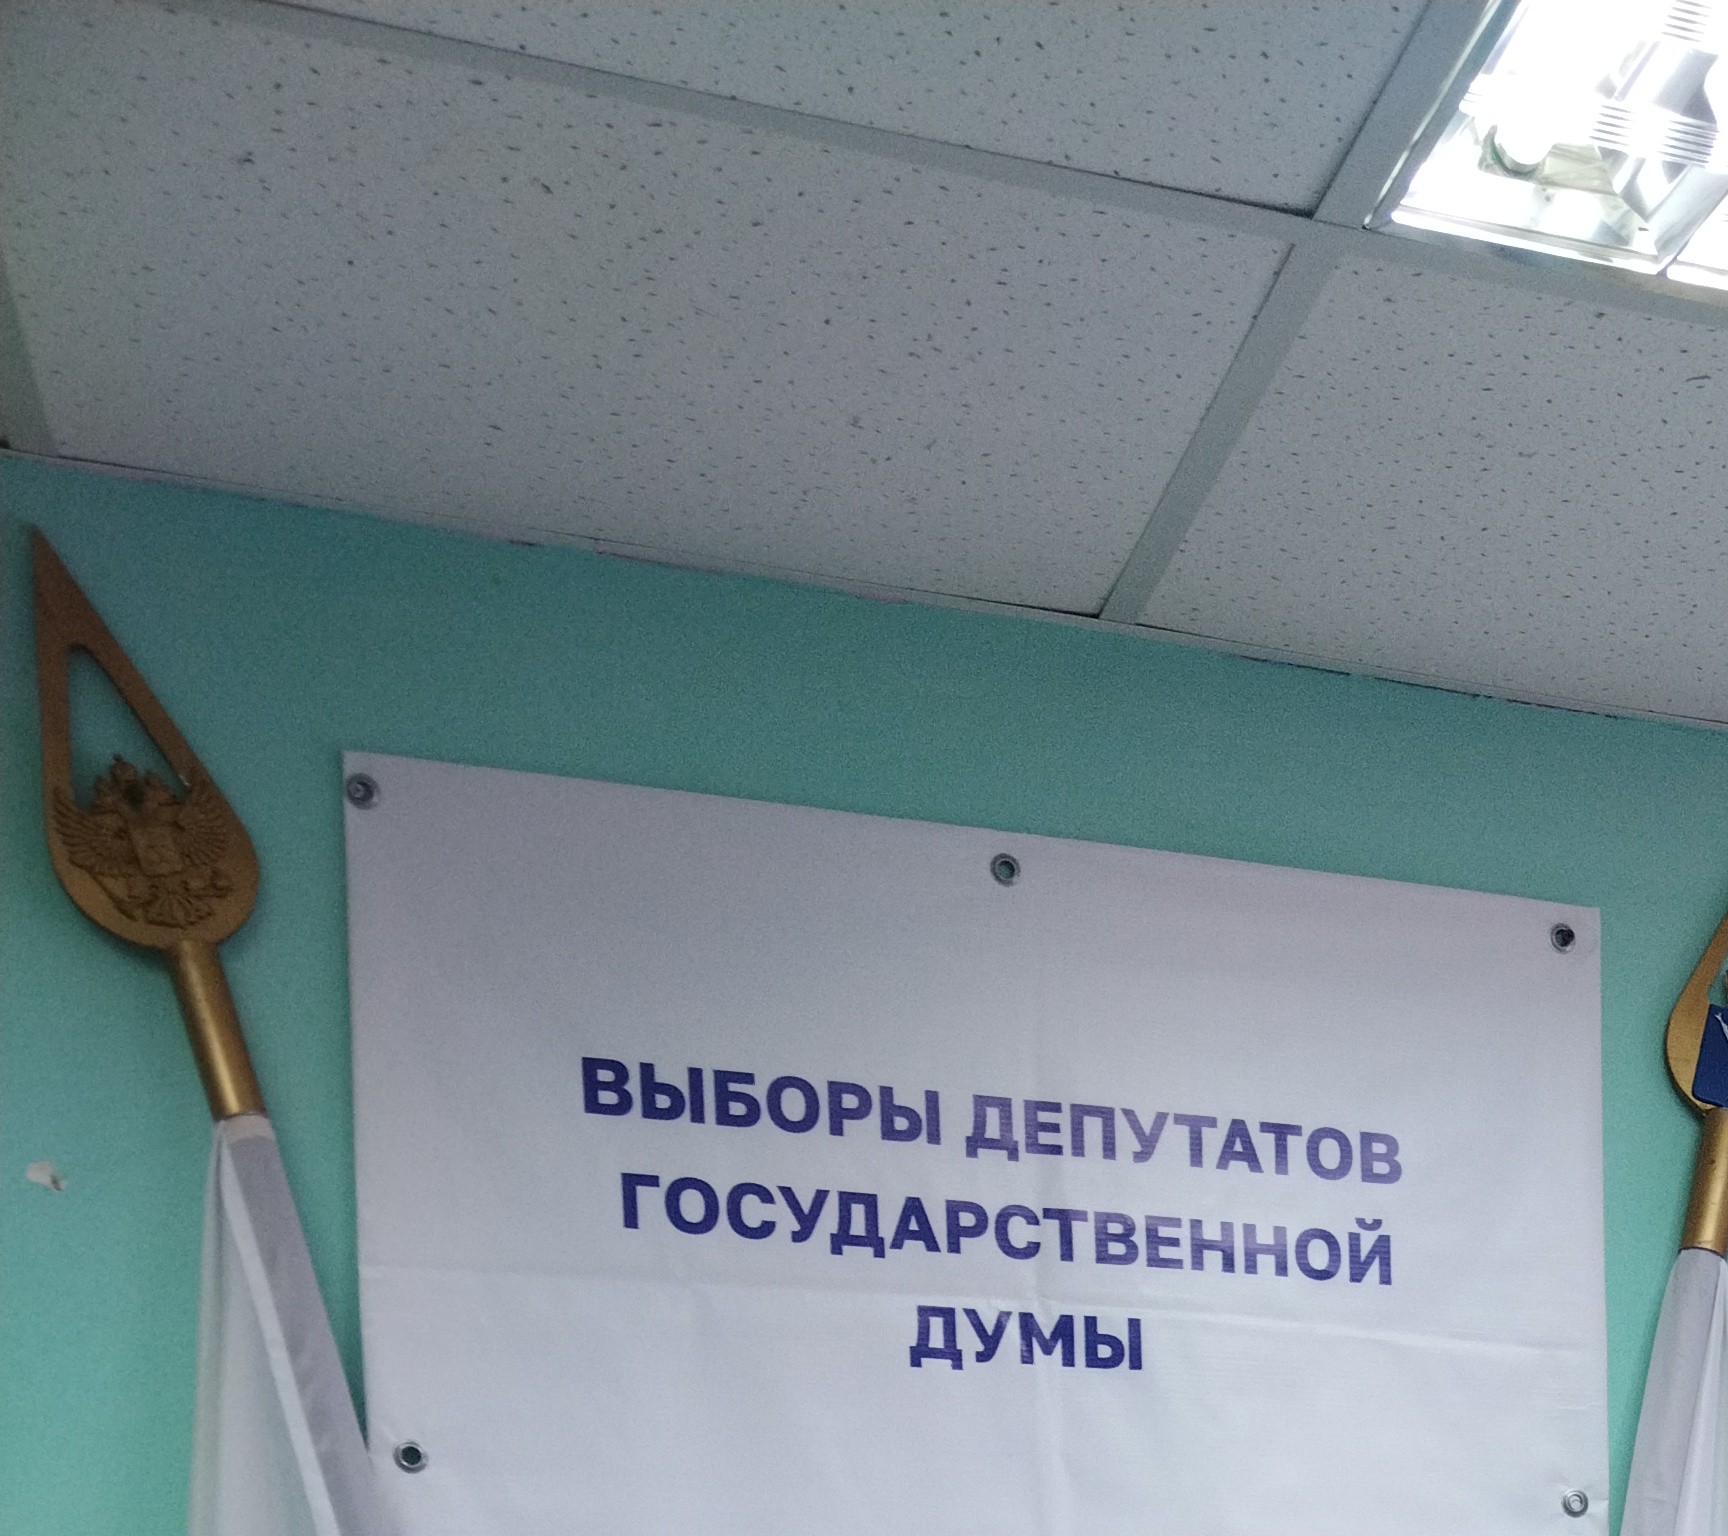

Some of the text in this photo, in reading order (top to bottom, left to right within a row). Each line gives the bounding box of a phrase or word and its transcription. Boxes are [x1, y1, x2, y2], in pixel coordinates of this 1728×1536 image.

[581, 1057, 1402, 1185] ВЫБОРЫ ДЕПУТАТОВ
[619, 1172, 1394, 1286] ГОСУДАРСТВЕННОЙ
[908, 1304, 1143, 1371] ДУМЫ
